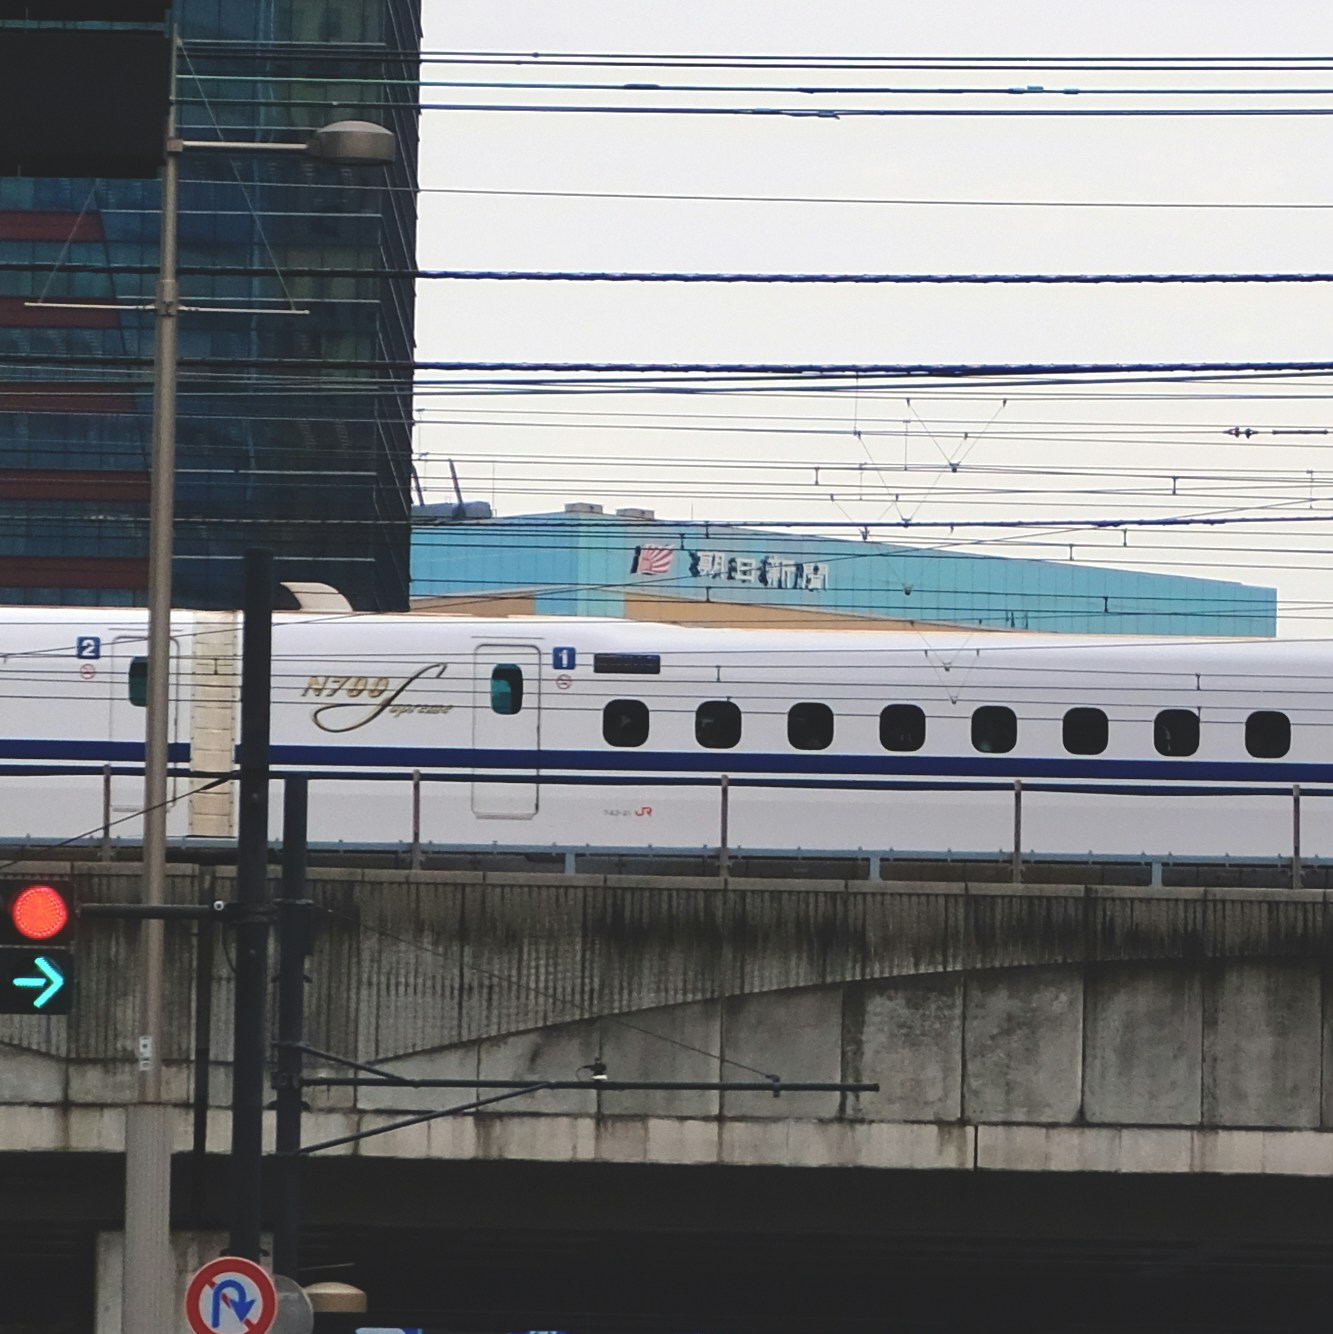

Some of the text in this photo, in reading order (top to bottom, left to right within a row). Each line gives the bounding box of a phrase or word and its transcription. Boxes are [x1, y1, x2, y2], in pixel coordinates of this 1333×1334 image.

[697, 549, 829, 591] 朝日新聞
[82, 640, 96, 656] 2
[559, 649, 569, 668] 1
[301, 675, 389, 698] N700
[634, 806, 653, 817] JR
